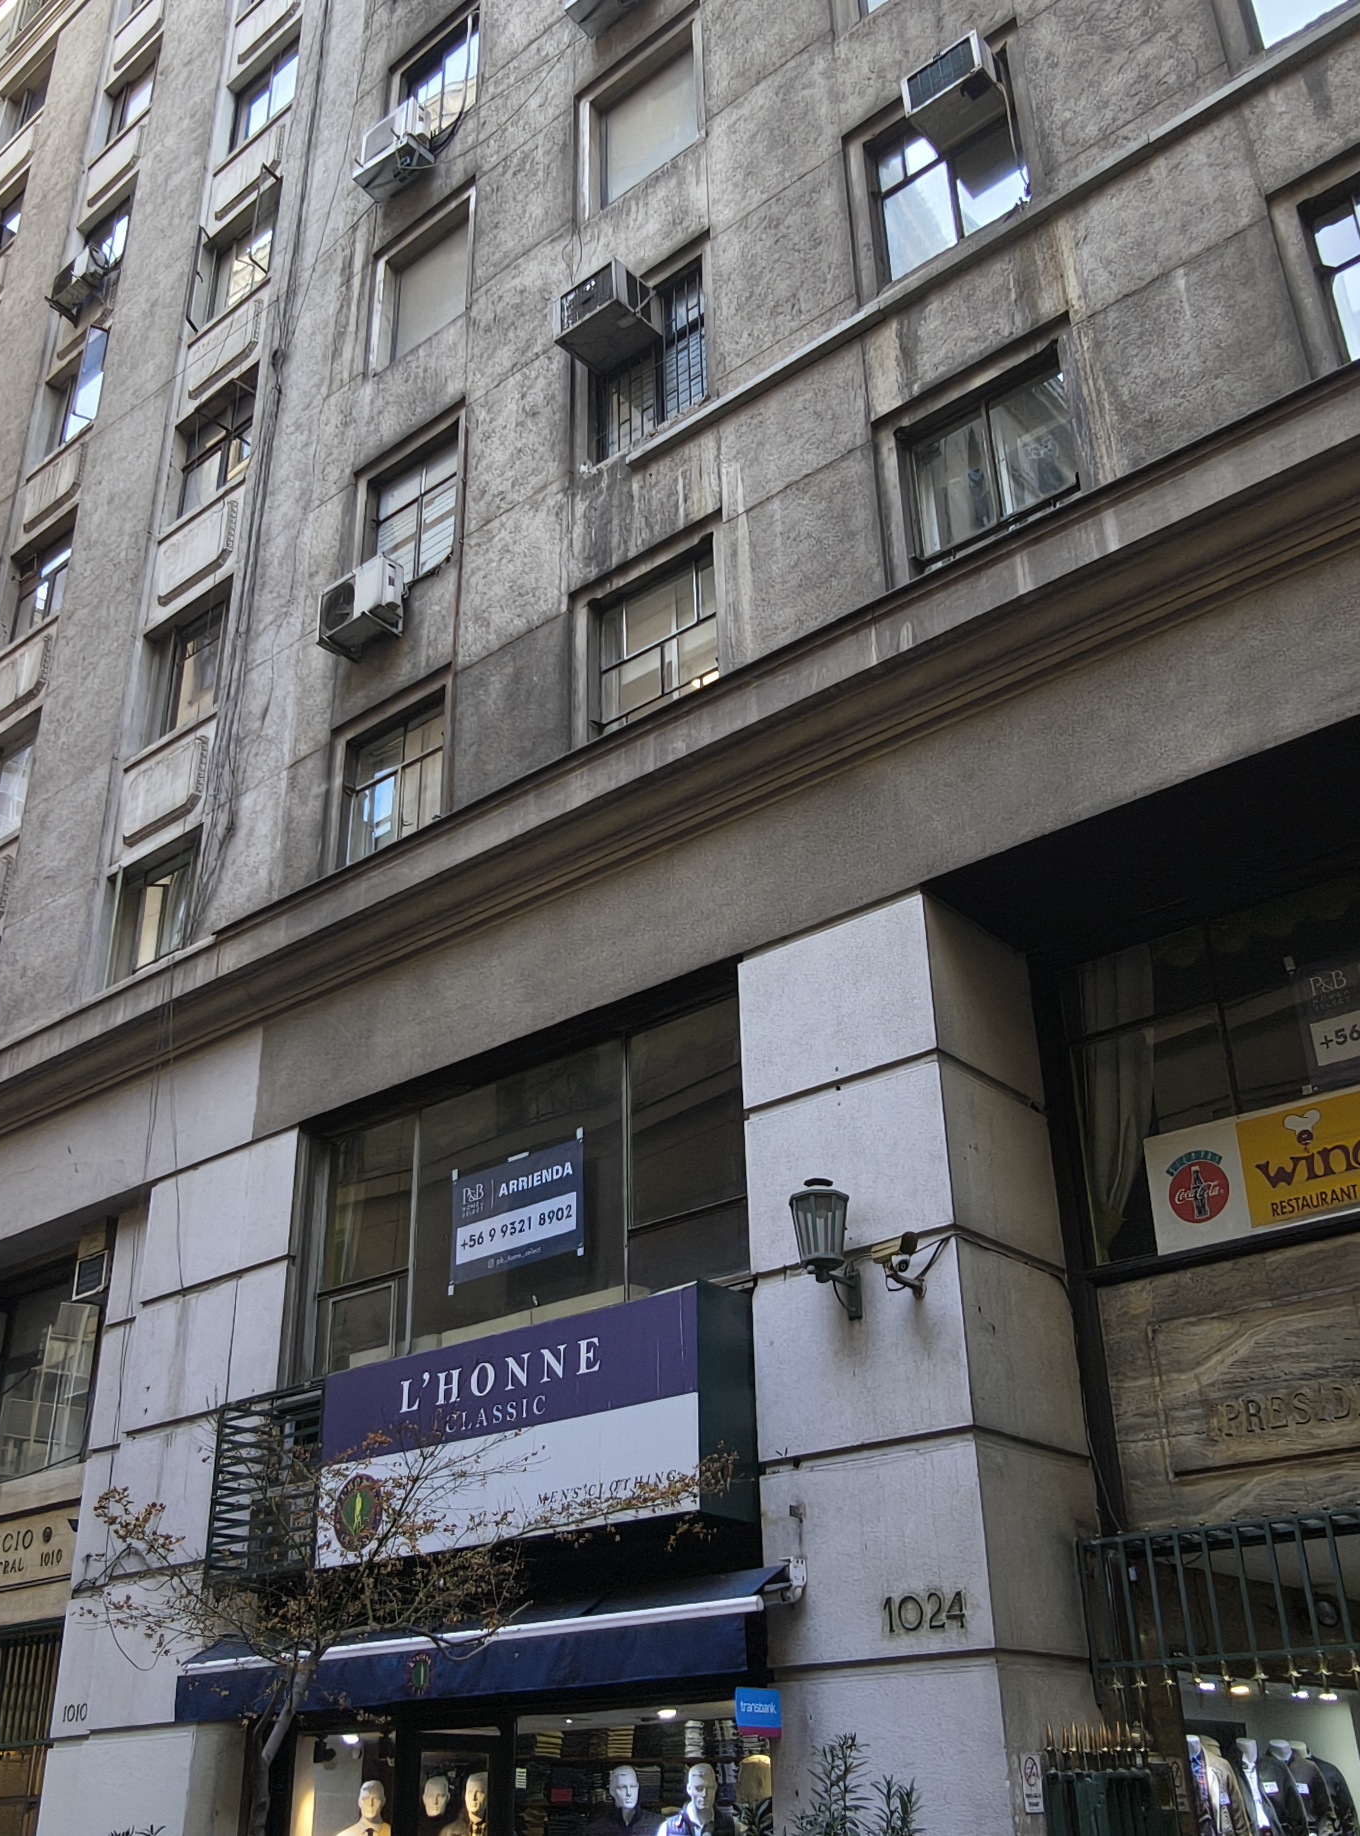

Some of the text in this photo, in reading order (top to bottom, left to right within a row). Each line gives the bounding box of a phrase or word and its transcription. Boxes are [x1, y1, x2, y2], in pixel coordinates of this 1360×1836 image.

[1309, 970, 1346, 997] P&B
[1319, 1023, 1360, 1049] +56
[462, 1161, 573, 1206] P&B ARRIENDA
[1271, 1184, 1359, 1218] RESTAURANT
[460, 1204, 572, 1250] +56 9 9321 8902
[445, 1395, 548, 1434] CLASSIC
[39, 1548, 63, 1567] 1010
[883, 1589, 967, 1634] 1024
[62, 1703, 88, 1722] 1010
[740, 1700, 777, 1715] transbank
